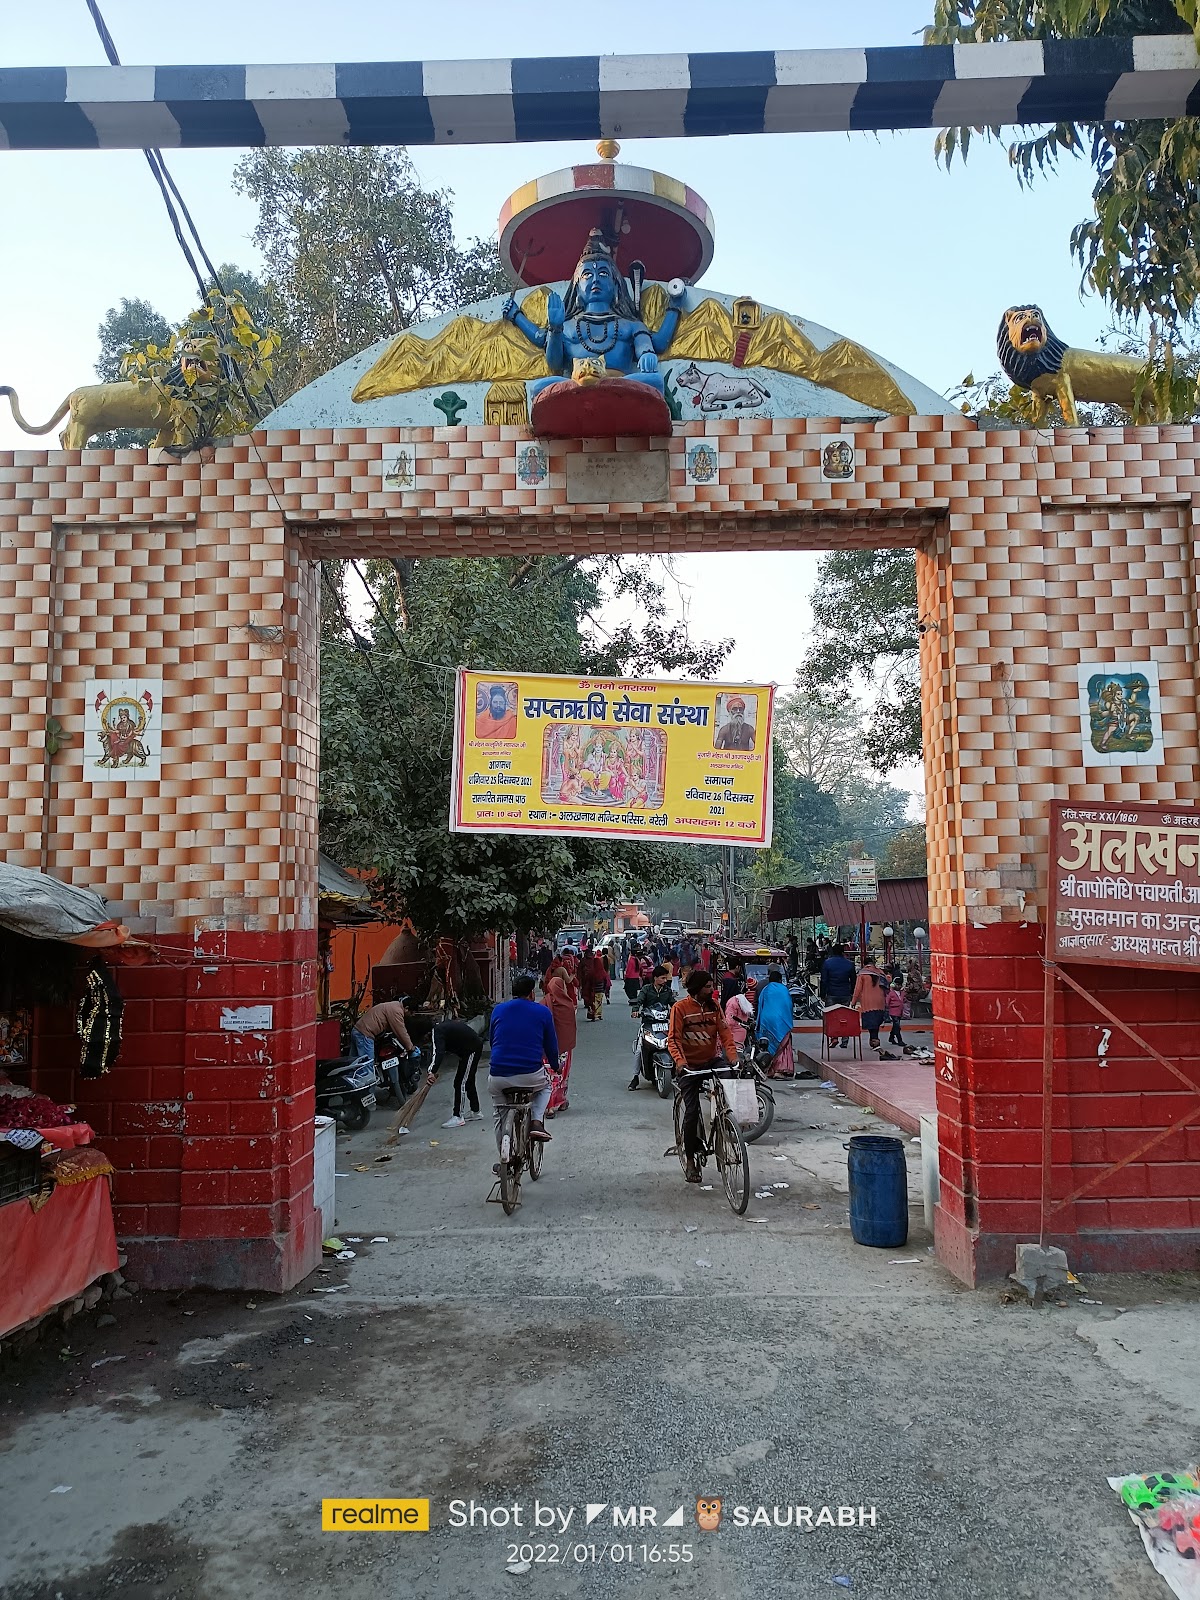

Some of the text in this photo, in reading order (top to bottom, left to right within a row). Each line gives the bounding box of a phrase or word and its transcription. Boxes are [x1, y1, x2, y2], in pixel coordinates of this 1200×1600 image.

[594, 683, 615, 691] नमो
[618, 684, 656, 693] नारायण
[524, 692, 709, 726] सप्तऋषि सेवा संस्था
[468, 773, 532, 786] शनिवार 25 दिसम्बर 2021
[705, 776, 734, 786] समापन
[472, 791, 526, 804] रामचरित मानस पाठ
[685, 788, 754, 803] रविवार 26 दिसम्बर
[507, 809, 522, 818] बजे
[528, 810, 547, 820] स्थान
[559, 811, 596, 822] अलखनाथ
[598, 811, 620, 824] मन्दिर
[709, 806, 725, 815] 2021
[738, 820, 756, 829] बजे
[1060, 874, 1076, 897] श्री
[1076, 875, 1134, 901] तापोनिधि
[1134, 879, 1183, 903] पंचायती
[1069, 908, 1138, 931] मुसलमान
[1141, 912, 1161, 931] का
[1111, 935, 1150, 955] अध्यक्ष
[1152, 938, 1181, 957] महन्त
[1182, 935, 1197, 957] श्री
